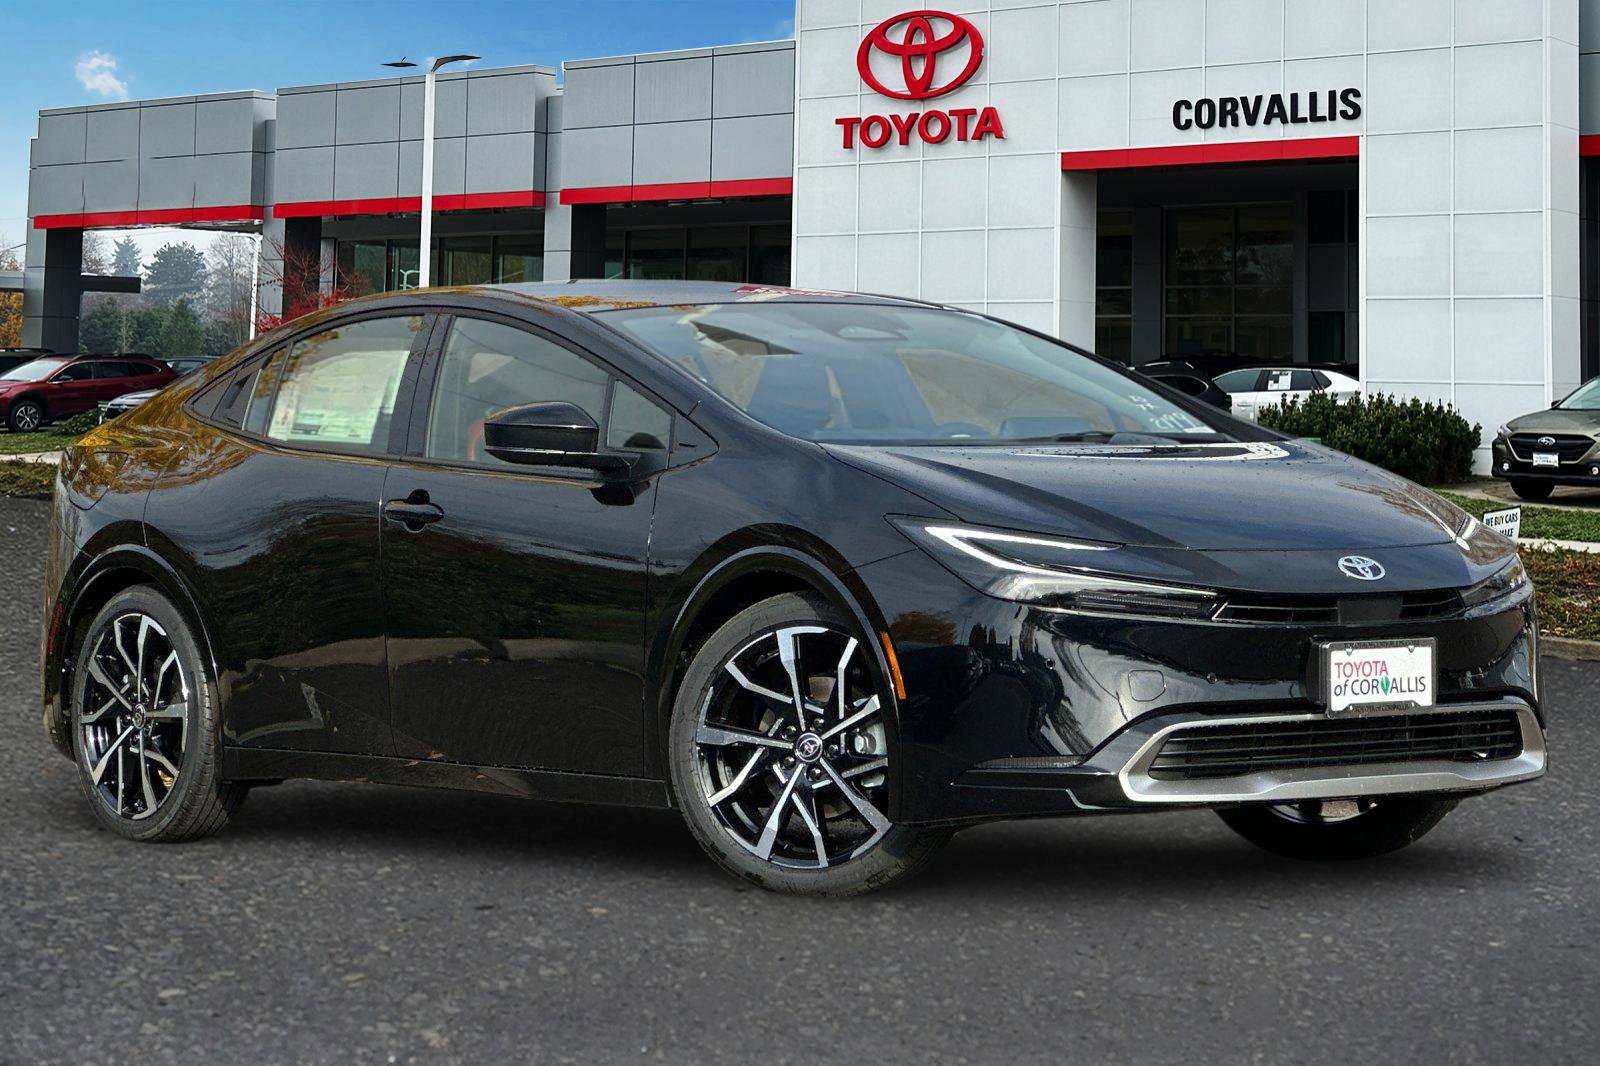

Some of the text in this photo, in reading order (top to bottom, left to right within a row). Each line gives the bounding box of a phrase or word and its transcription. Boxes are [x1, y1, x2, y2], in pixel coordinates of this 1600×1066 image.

[1172, 87, 1362, 131] CORVALLIS
[835, 106, 1005, 149] TOYOTA
[1505, 512, 1519, 524] CARS
[1334, 660, 1389, 678] TOYOTA
[1333, 679, 1350, 697] of
